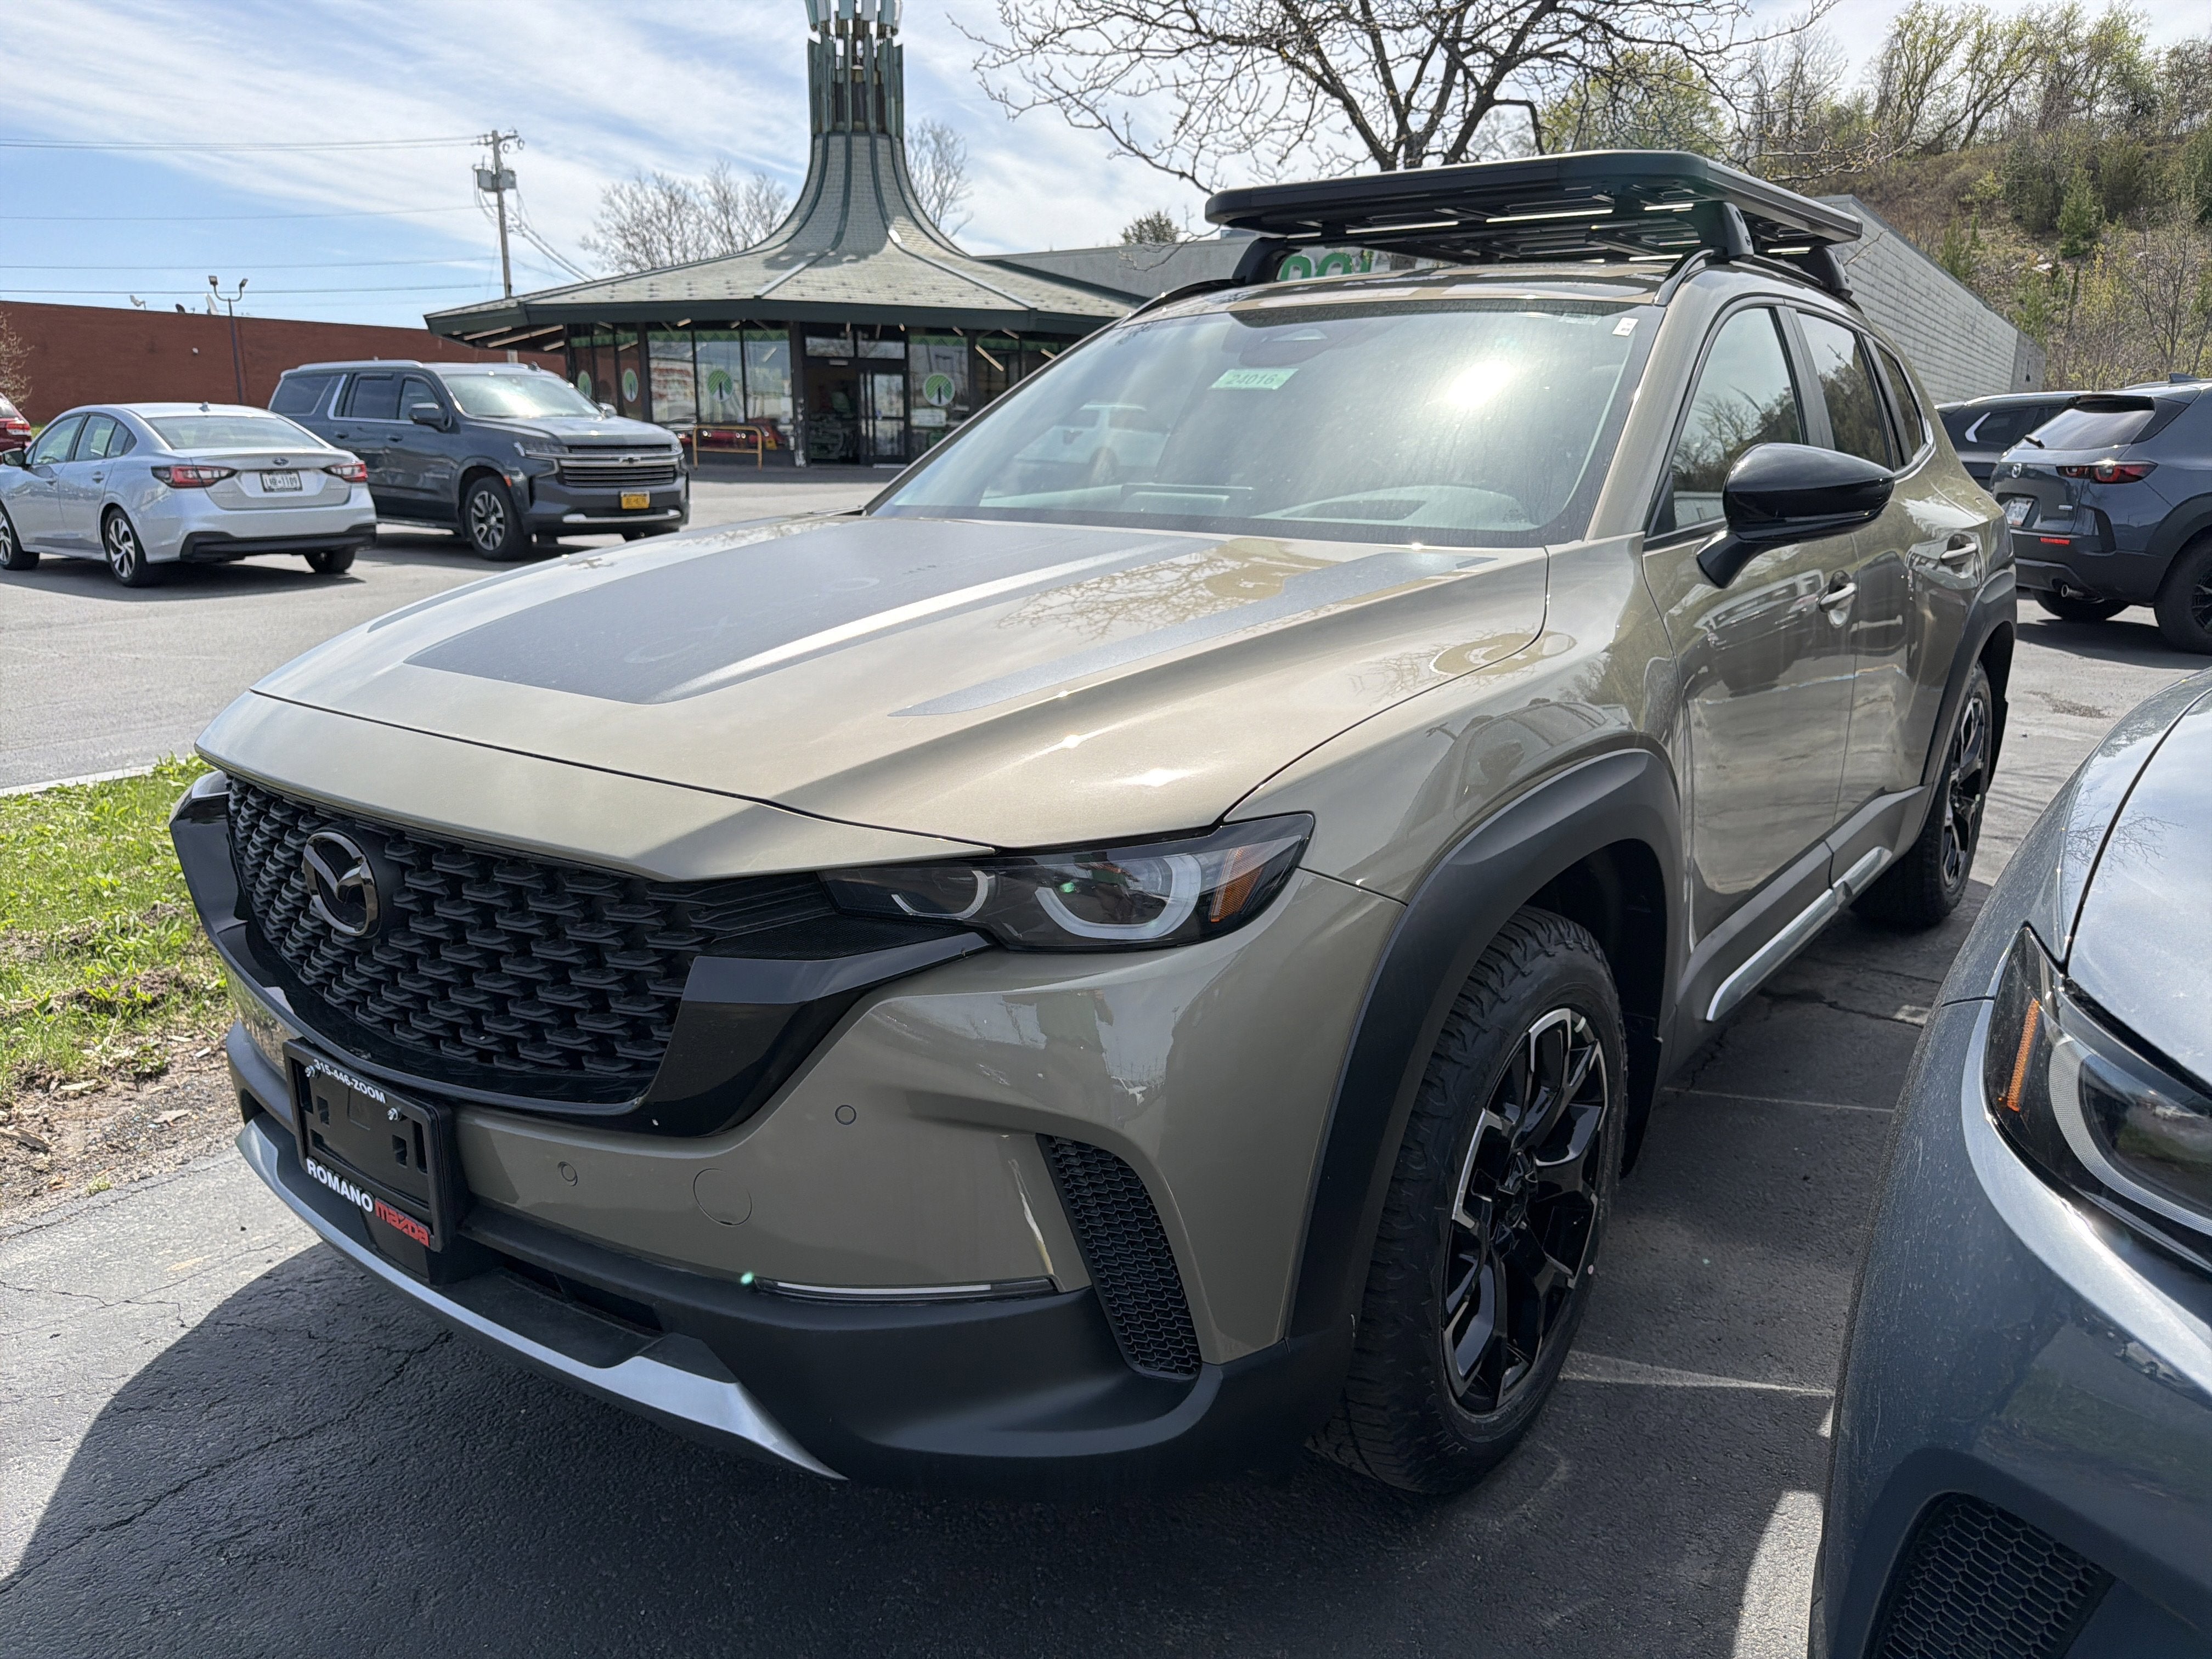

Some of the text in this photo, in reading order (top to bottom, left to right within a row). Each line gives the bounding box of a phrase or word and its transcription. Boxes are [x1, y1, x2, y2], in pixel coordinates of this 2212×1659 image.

[1226, 374, 1278, 385] 24016
[314, 1058, 386, 1104] 315-446-ZOOM
[306, 1158, 374, 1213] ROMANO
